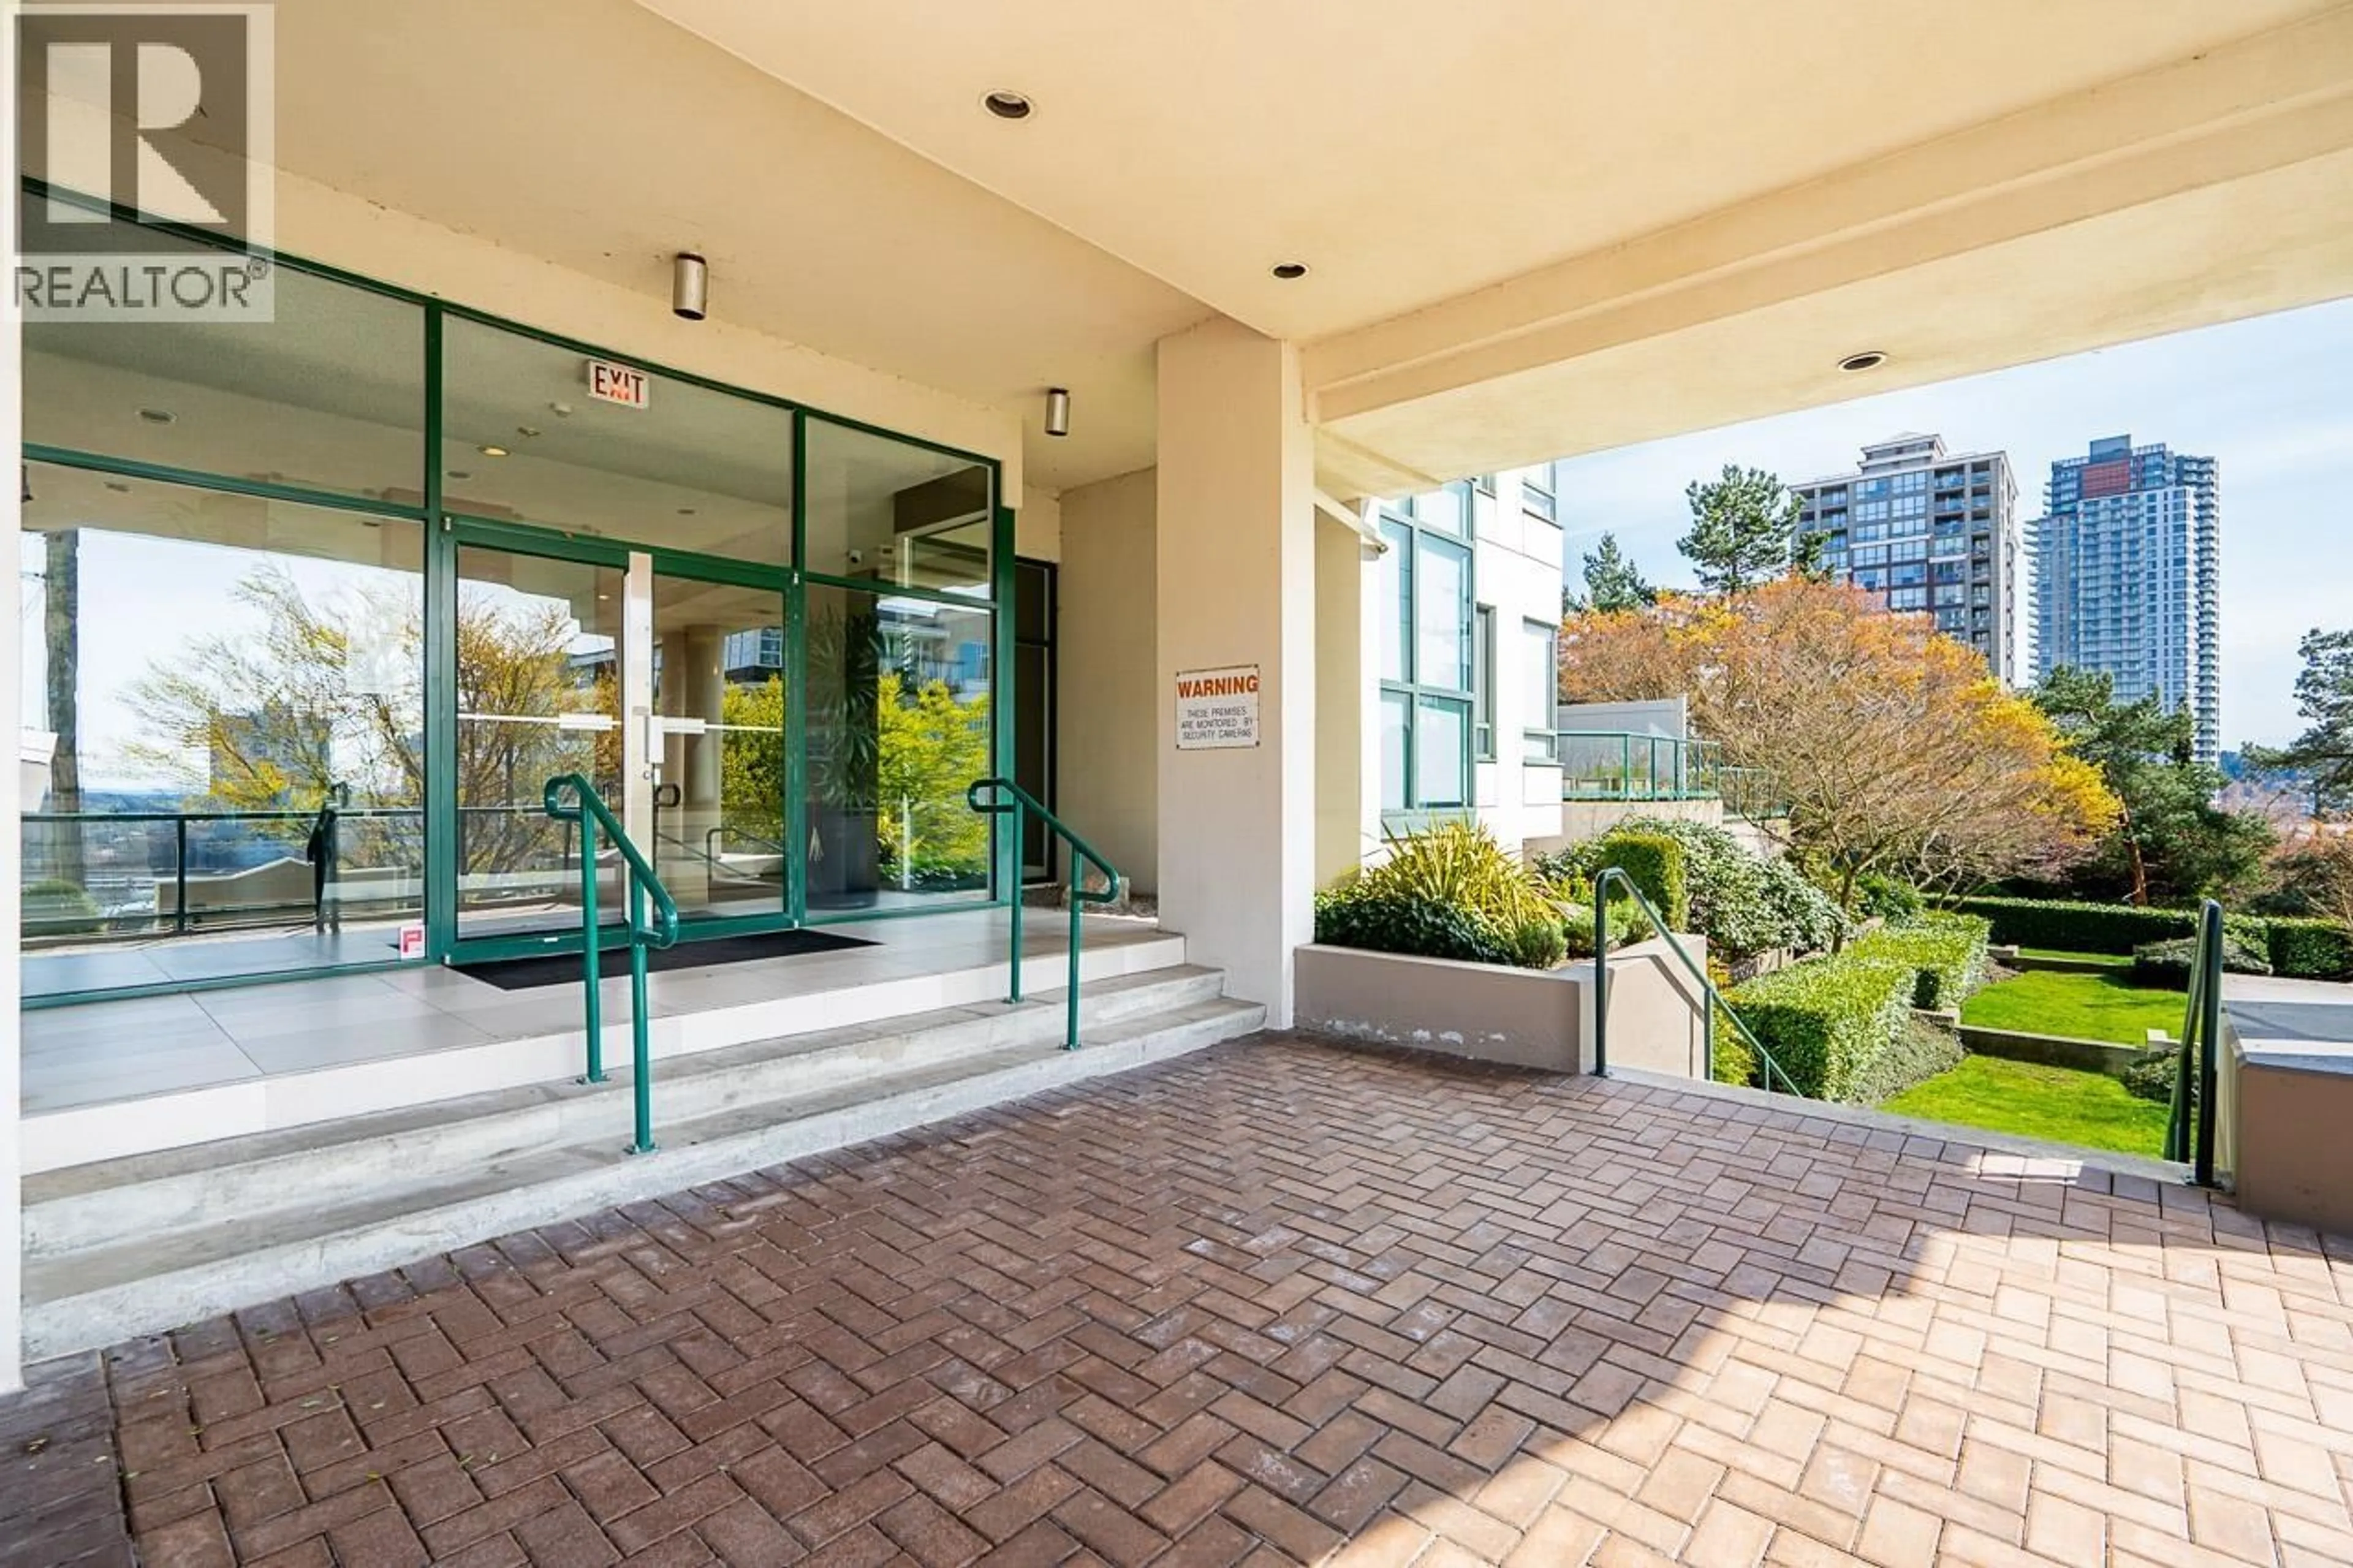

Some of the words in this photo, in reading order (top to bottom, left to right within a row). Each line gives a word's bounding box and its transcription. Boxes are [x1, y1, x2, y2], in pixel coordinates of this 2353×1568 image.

[595, 365, 644, 403] EXIT
[1178, 675, 1258, 698] WARNING
[1188, 709, 1208, 718] THESE
[1211, 706, 1247, 716] PREMISES
[1181, 720, 1193, 729] ARE
[1197, 718, 1237, 729] MONITORED
[1244, 717, 1252, 726] BY
[1183, 730, 1215, 740] SECURITY
[1218, 728, 1252, 738] CAMERAS
